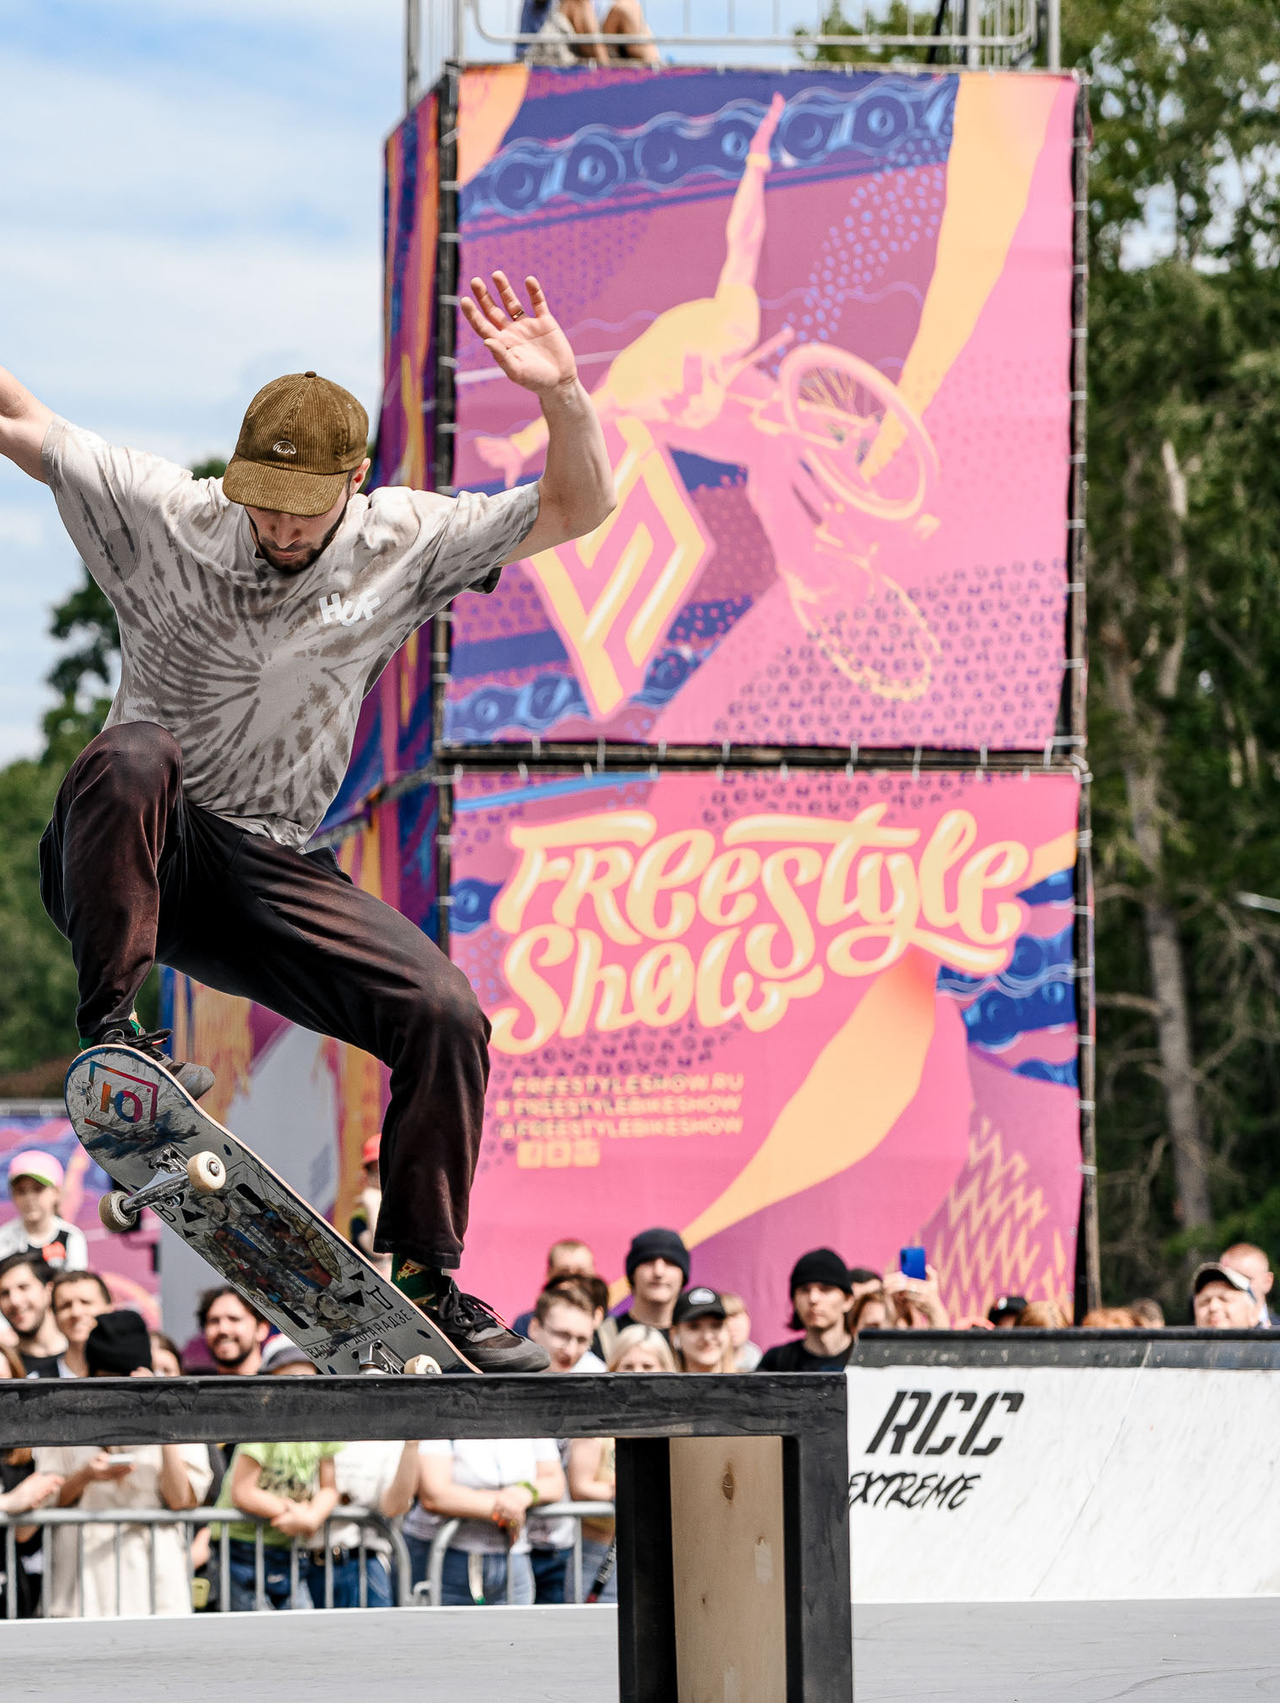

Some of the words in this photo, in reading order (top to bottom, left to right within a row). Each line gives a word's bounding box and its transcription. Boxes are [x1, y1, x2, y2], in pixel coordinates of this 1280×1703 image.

[319, 589, 382, 627] HUF
[865, 1391, 1024, 1456] RCC
[848, 1472, 981, 1510] EXTREME
